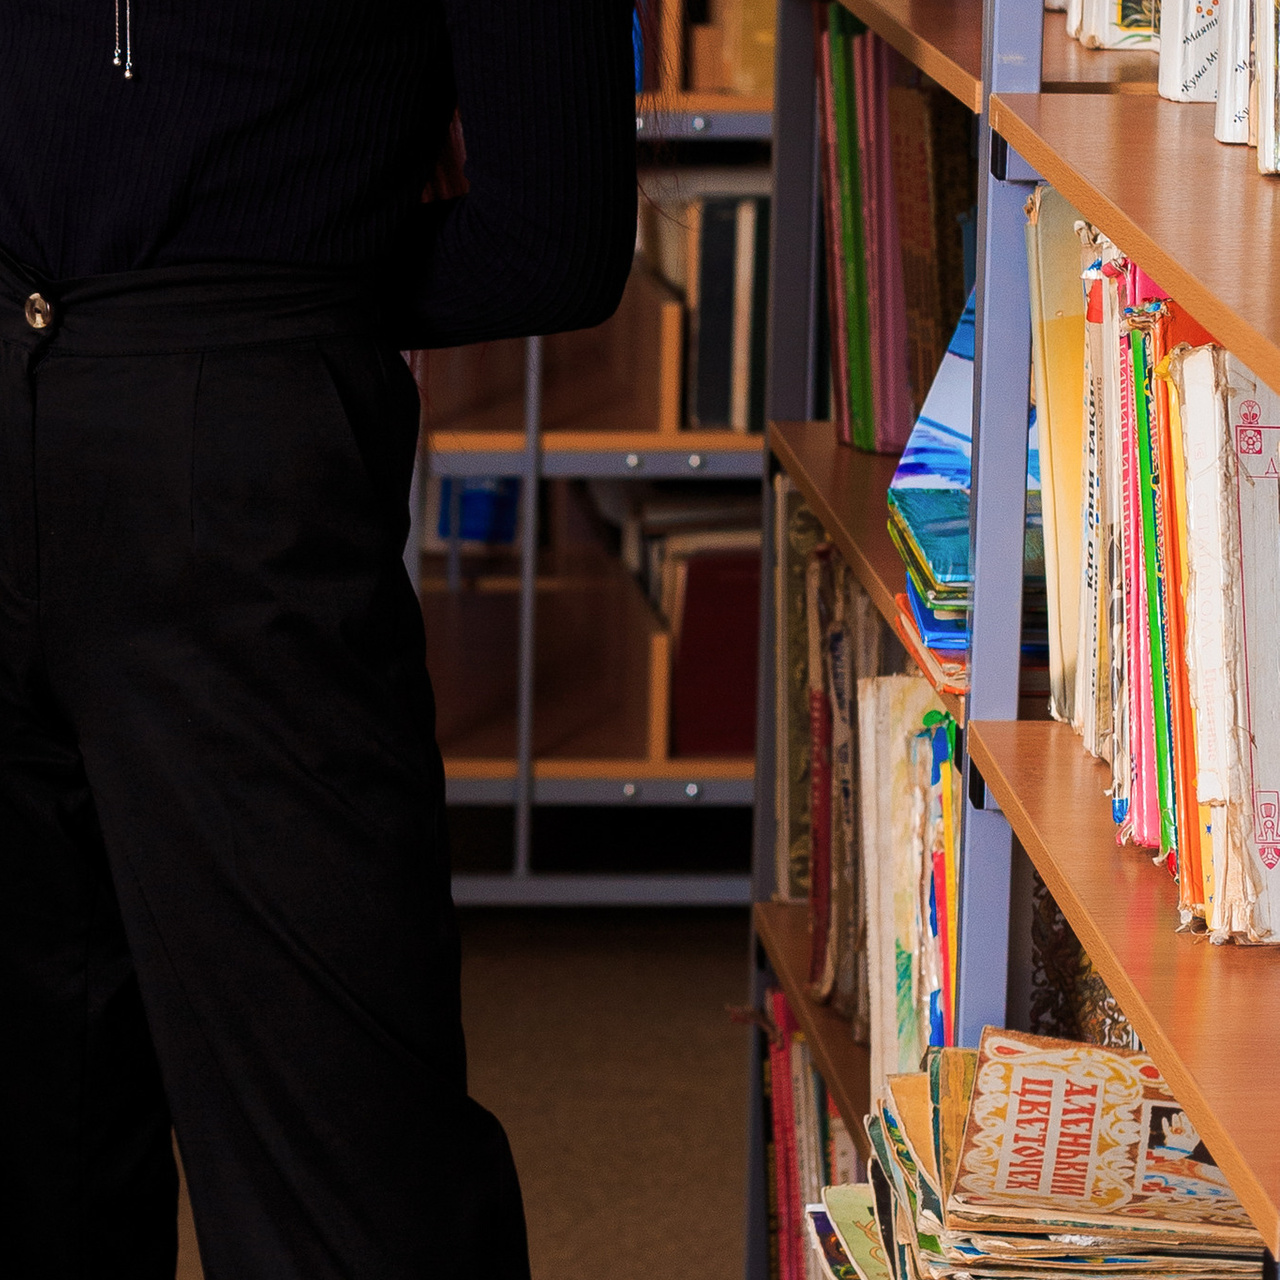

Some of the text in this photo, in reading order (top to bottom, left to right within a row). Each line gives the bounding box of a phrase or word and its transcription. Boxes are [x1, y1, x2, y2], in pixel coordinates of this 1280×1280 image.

[1183, 65, 1208, 92] Кума
[1087, 469, 1095, 530] ОНИ
[1086, 541, 1094, 590] КТО
[1204, 667, 1219, 761] Приятные
[1005, 1076, 1054, 1193] ЦВЕТОЧЕК
[1050, 1078, 1103, 1197] АЛЕНЬКИЙ
